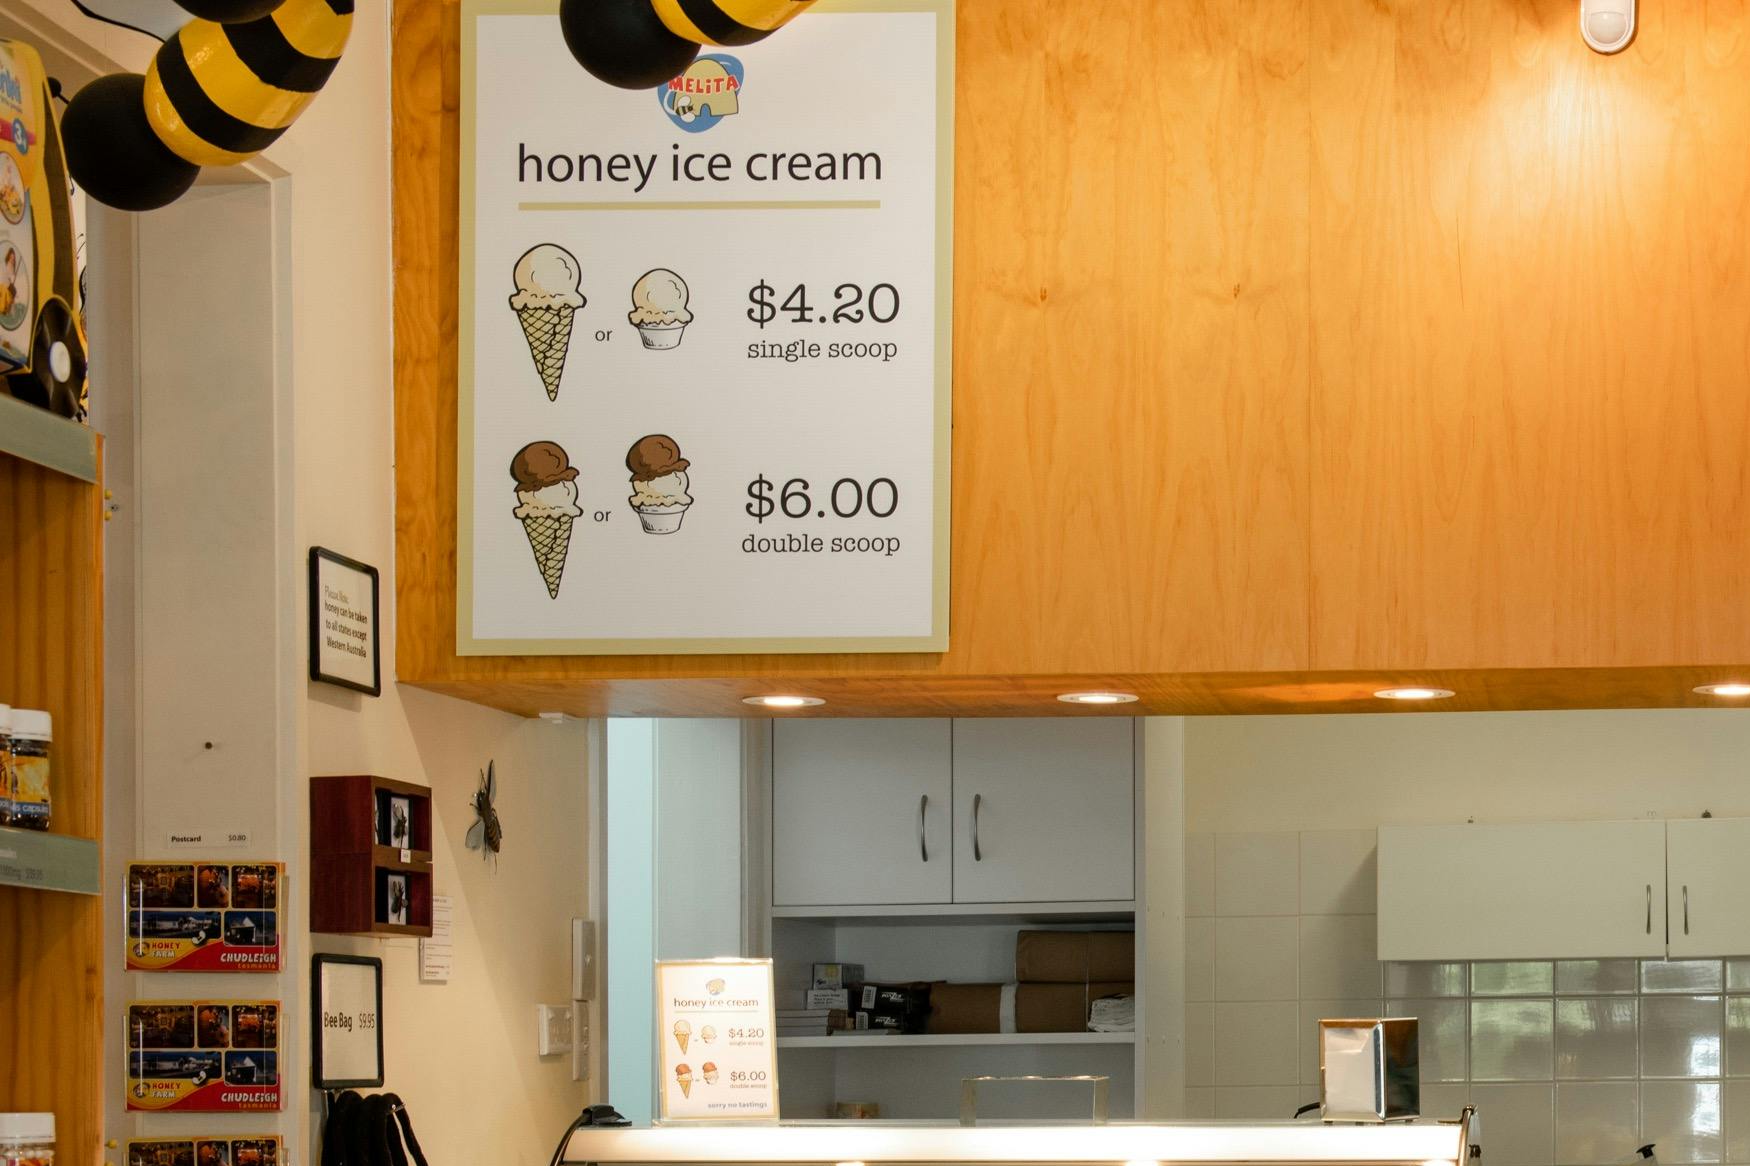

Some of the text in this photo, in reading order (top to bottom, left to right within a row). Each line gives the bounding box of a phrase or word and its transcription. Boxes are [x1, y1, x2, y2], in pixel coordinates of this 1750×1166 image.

[518, 143, 882, 193] honey ice cream
[747, 279, 899, 329] $4.20
[595, 329, 612, 342] or
[748, 338, 898, 361] single scoop
[745, 473, 899, 523] $6.00
[593, 510, 611, 523] or
[741, 533, 901, 556] double scoop
[171, 835, 202, 844] Postcard
[151, 941, 180, 950] HONEY
[674, 998, 759, 1008] honey ice cream
[324, 1012, 375, 1032] Bee Bag $9.95
[728, 1028, 764, 1039] $4.20
[730, 1071, 766, 1081] $6.00
